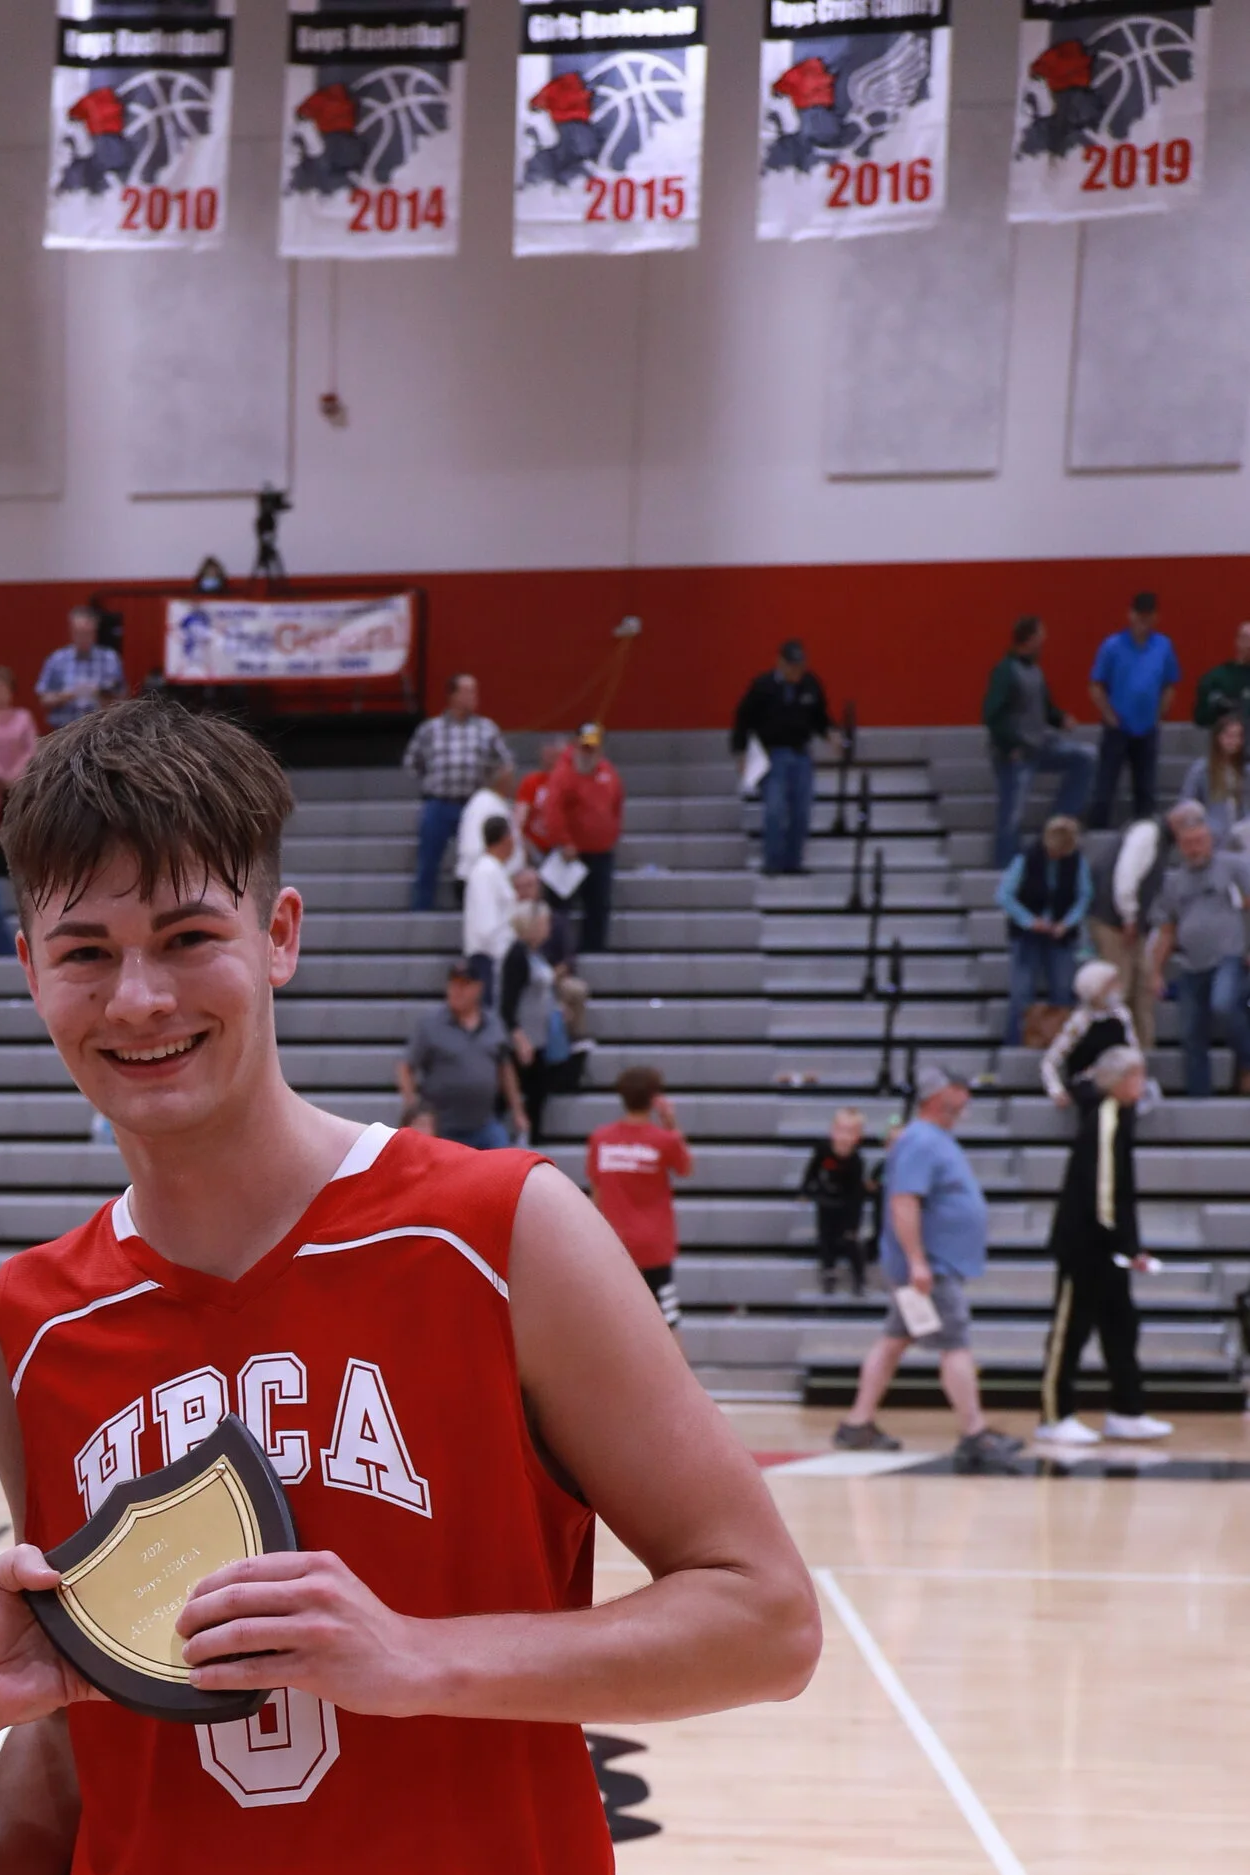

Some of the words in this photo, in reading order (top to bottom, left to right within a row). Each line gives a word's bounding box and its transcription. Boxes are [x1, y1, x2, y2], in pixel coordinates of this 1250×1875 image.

[826, 157, 932, 209] 2016
[1080, 137, 1192, 193] 2019
[120, 185, 218, 232] 2010
[347, 185, 446, 233] 2014
[584, 176, 687, 222] 2015
